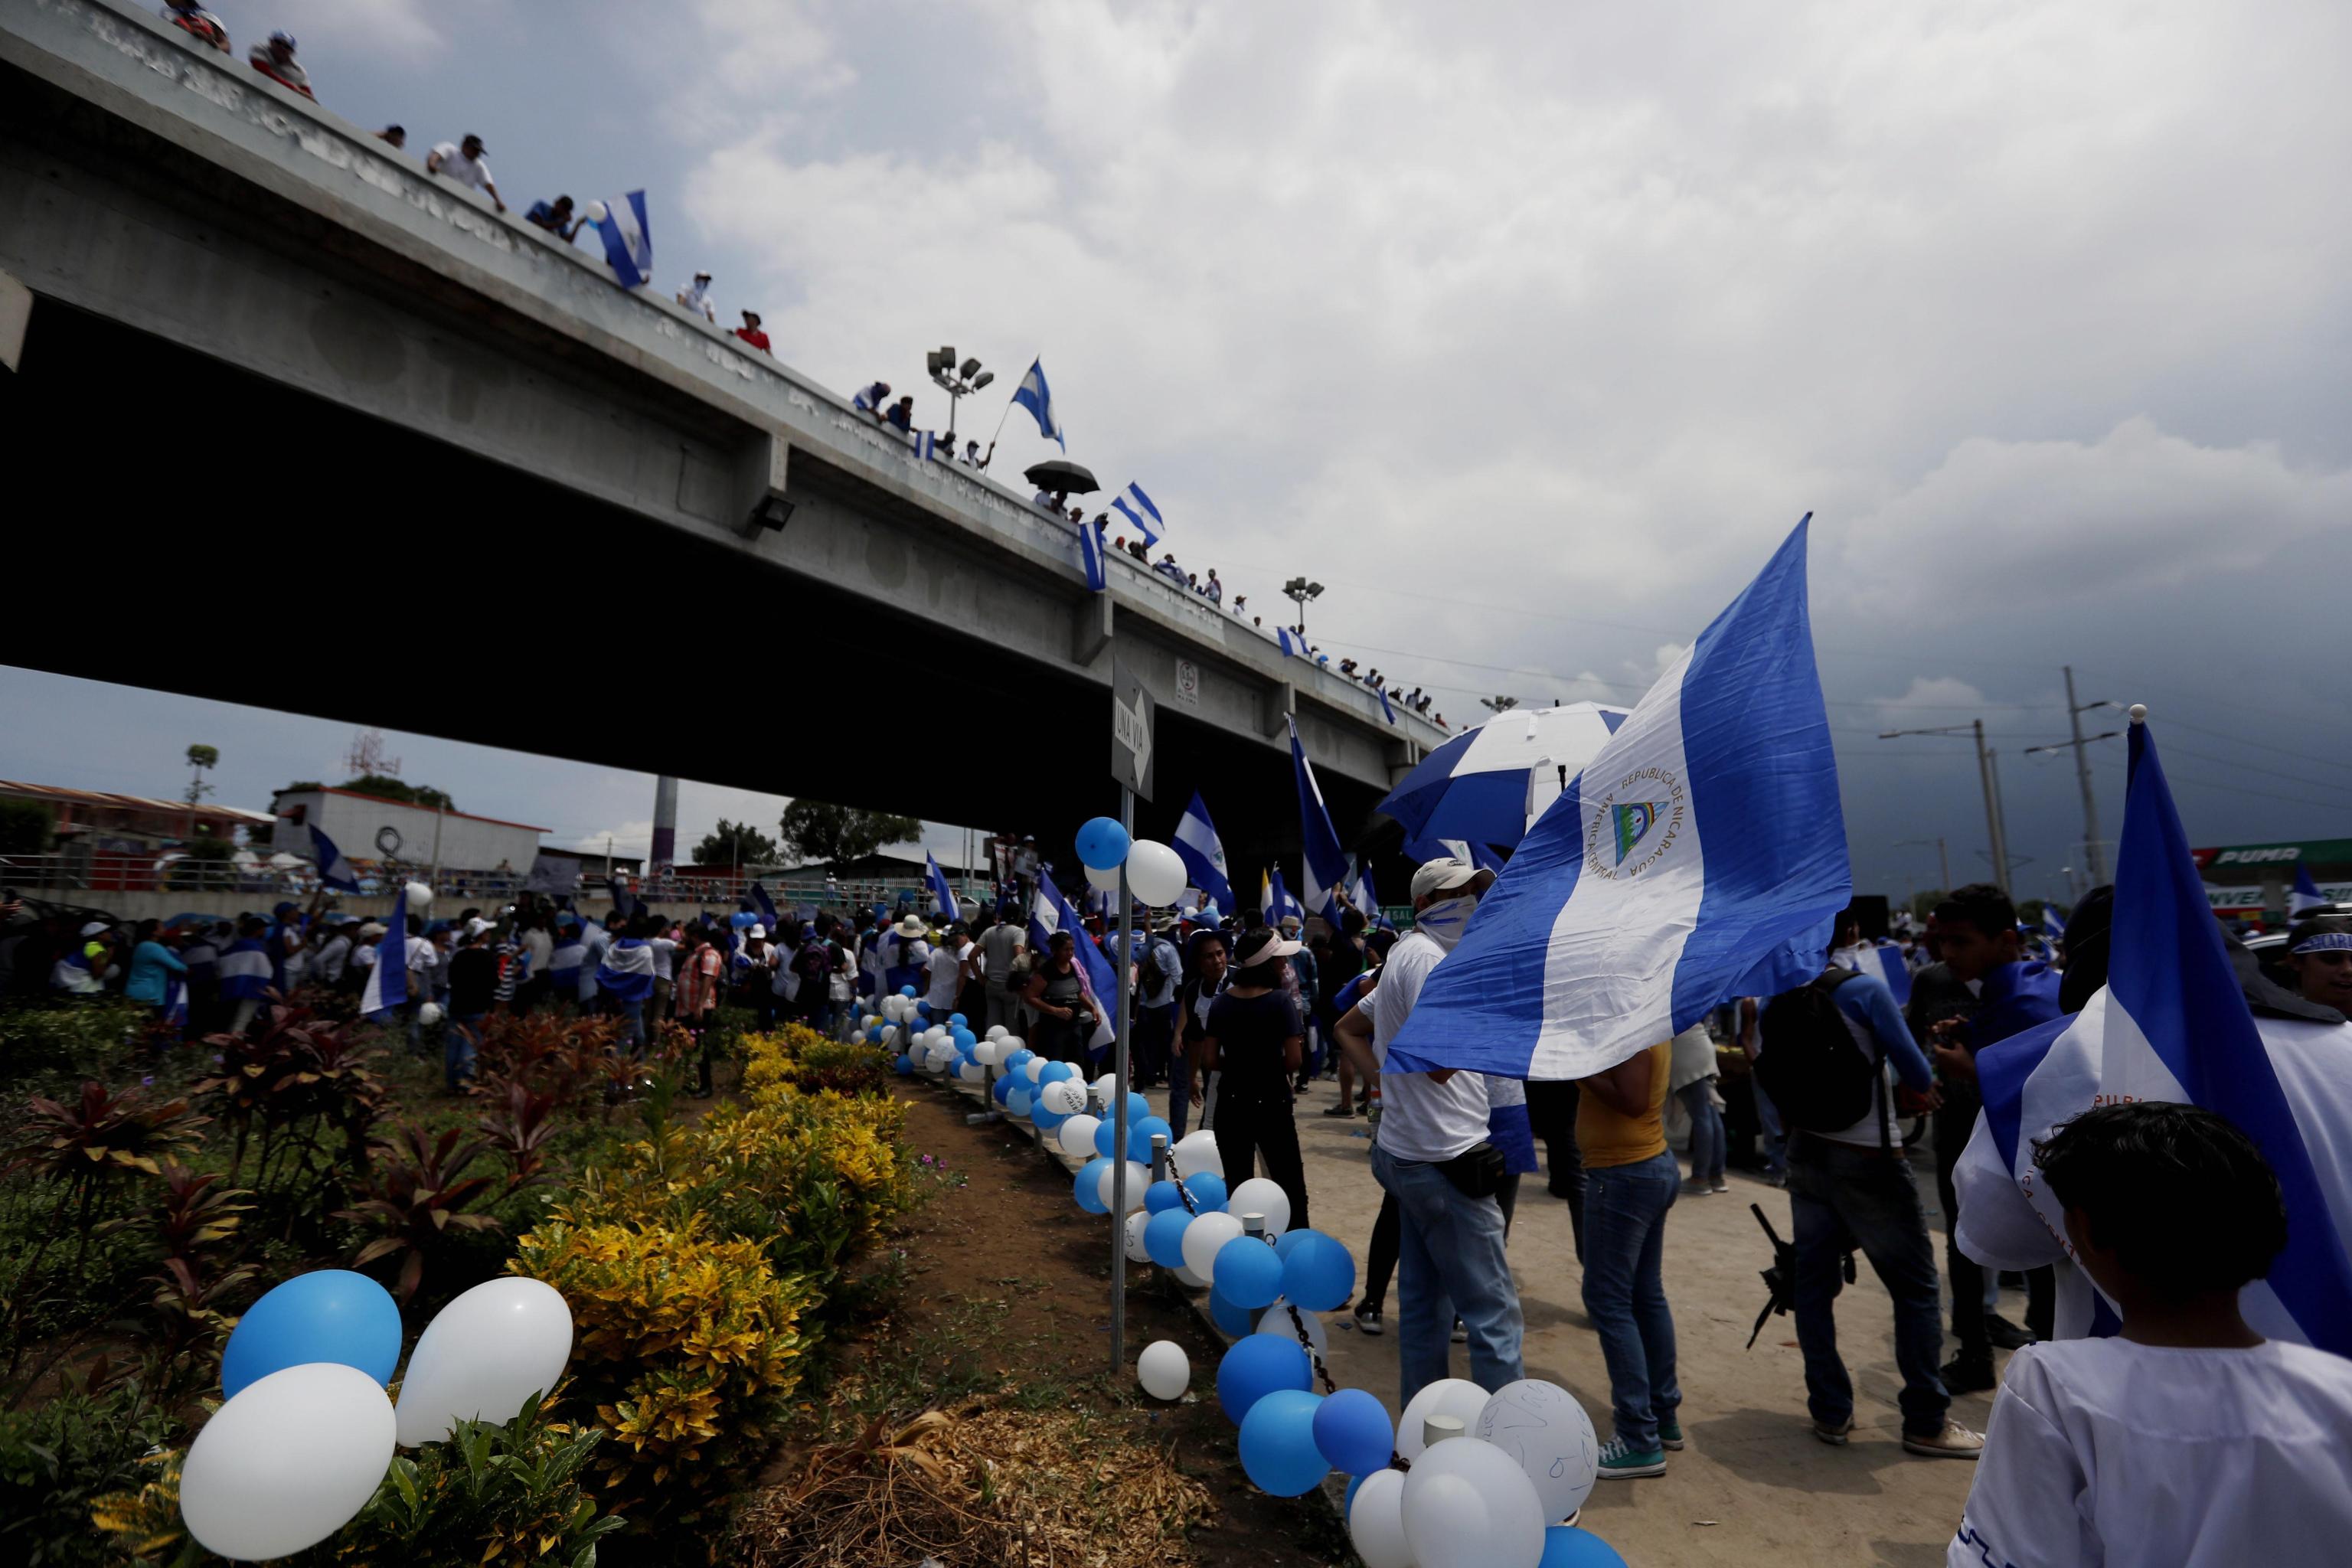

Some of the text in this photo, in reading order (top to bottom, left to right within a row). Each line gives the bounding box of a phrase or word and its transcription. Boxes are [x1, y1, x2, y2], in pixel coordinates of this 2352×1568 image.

[1117, 704, 1143, 754] UNA VIA
[1587, 792, 1618, 880] AMERICA CENTRAL
[1622, 767, 1684, 877] REPUBLICA DE NICARAGUA
[2216, 848, 2302, 864] PUMA
[2022, 1170, 2034, 1199] ICA
